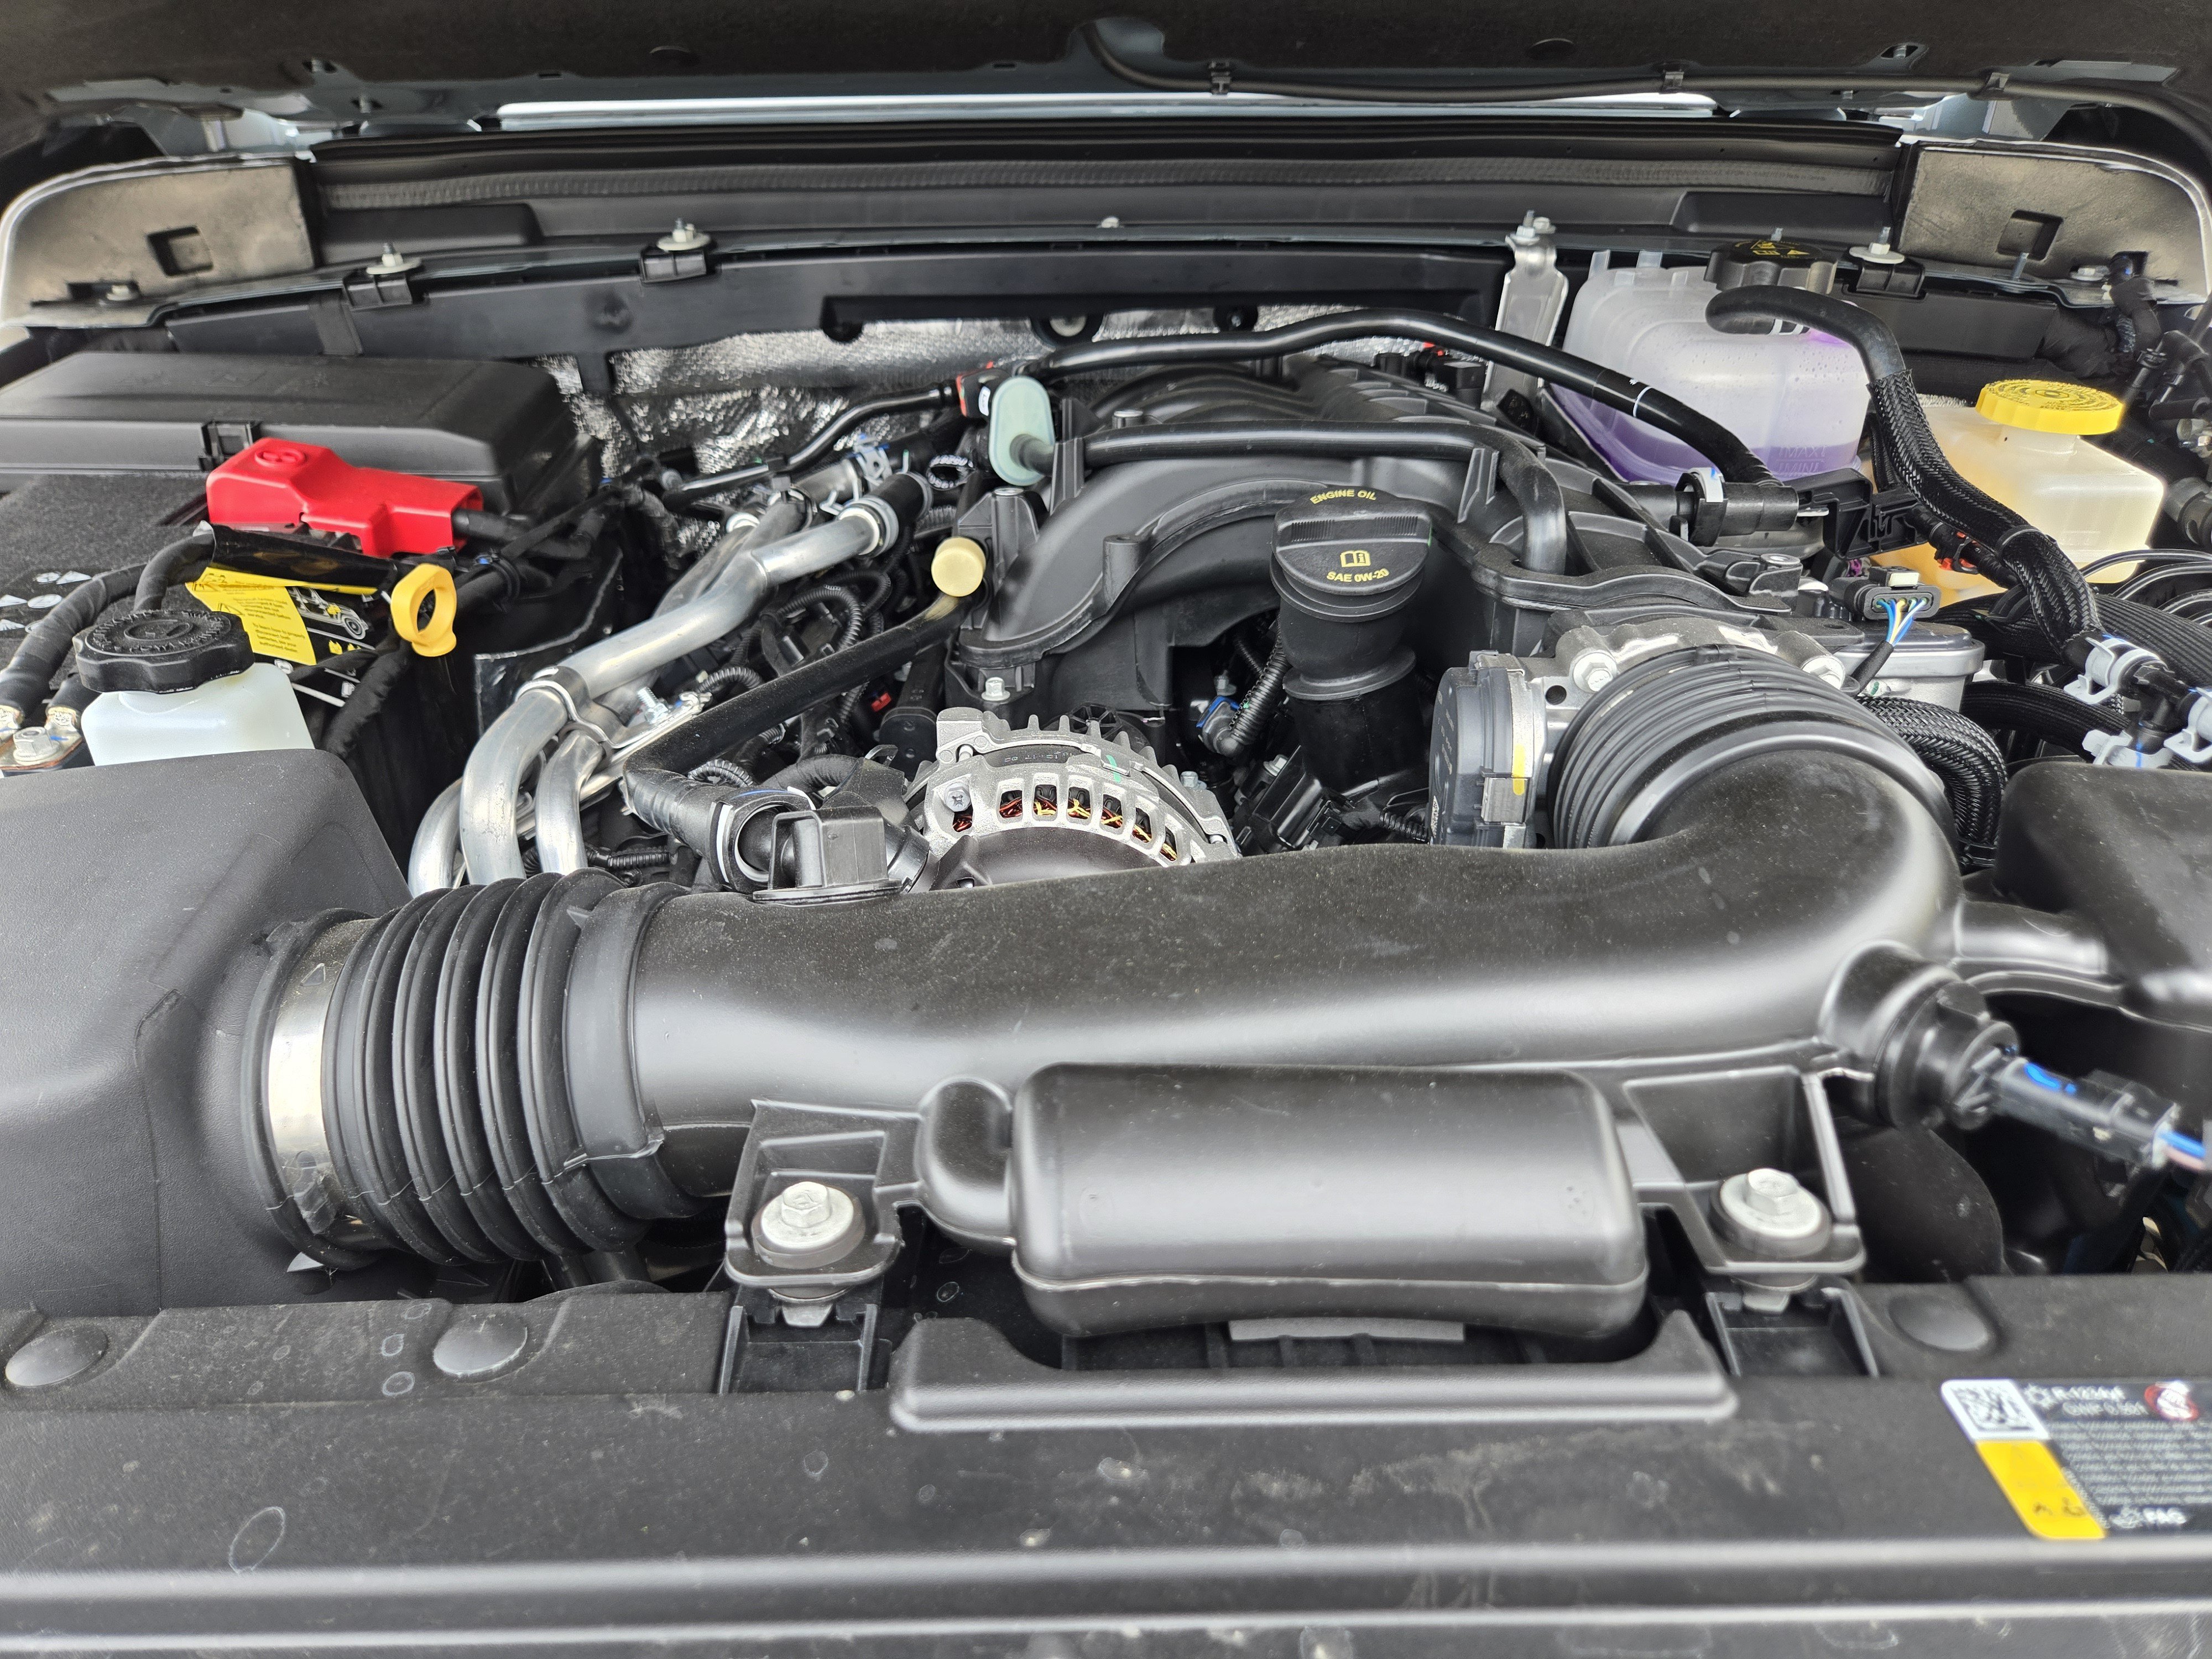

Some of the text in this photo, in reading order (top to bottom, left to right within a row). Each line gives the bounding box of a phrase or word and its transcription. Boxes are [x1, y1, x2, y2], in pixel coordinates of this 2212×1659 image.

[1310, 489, 1377, 504] ENGINE OIL
[1326, 568, 1390, 582] SAE 0W-20
